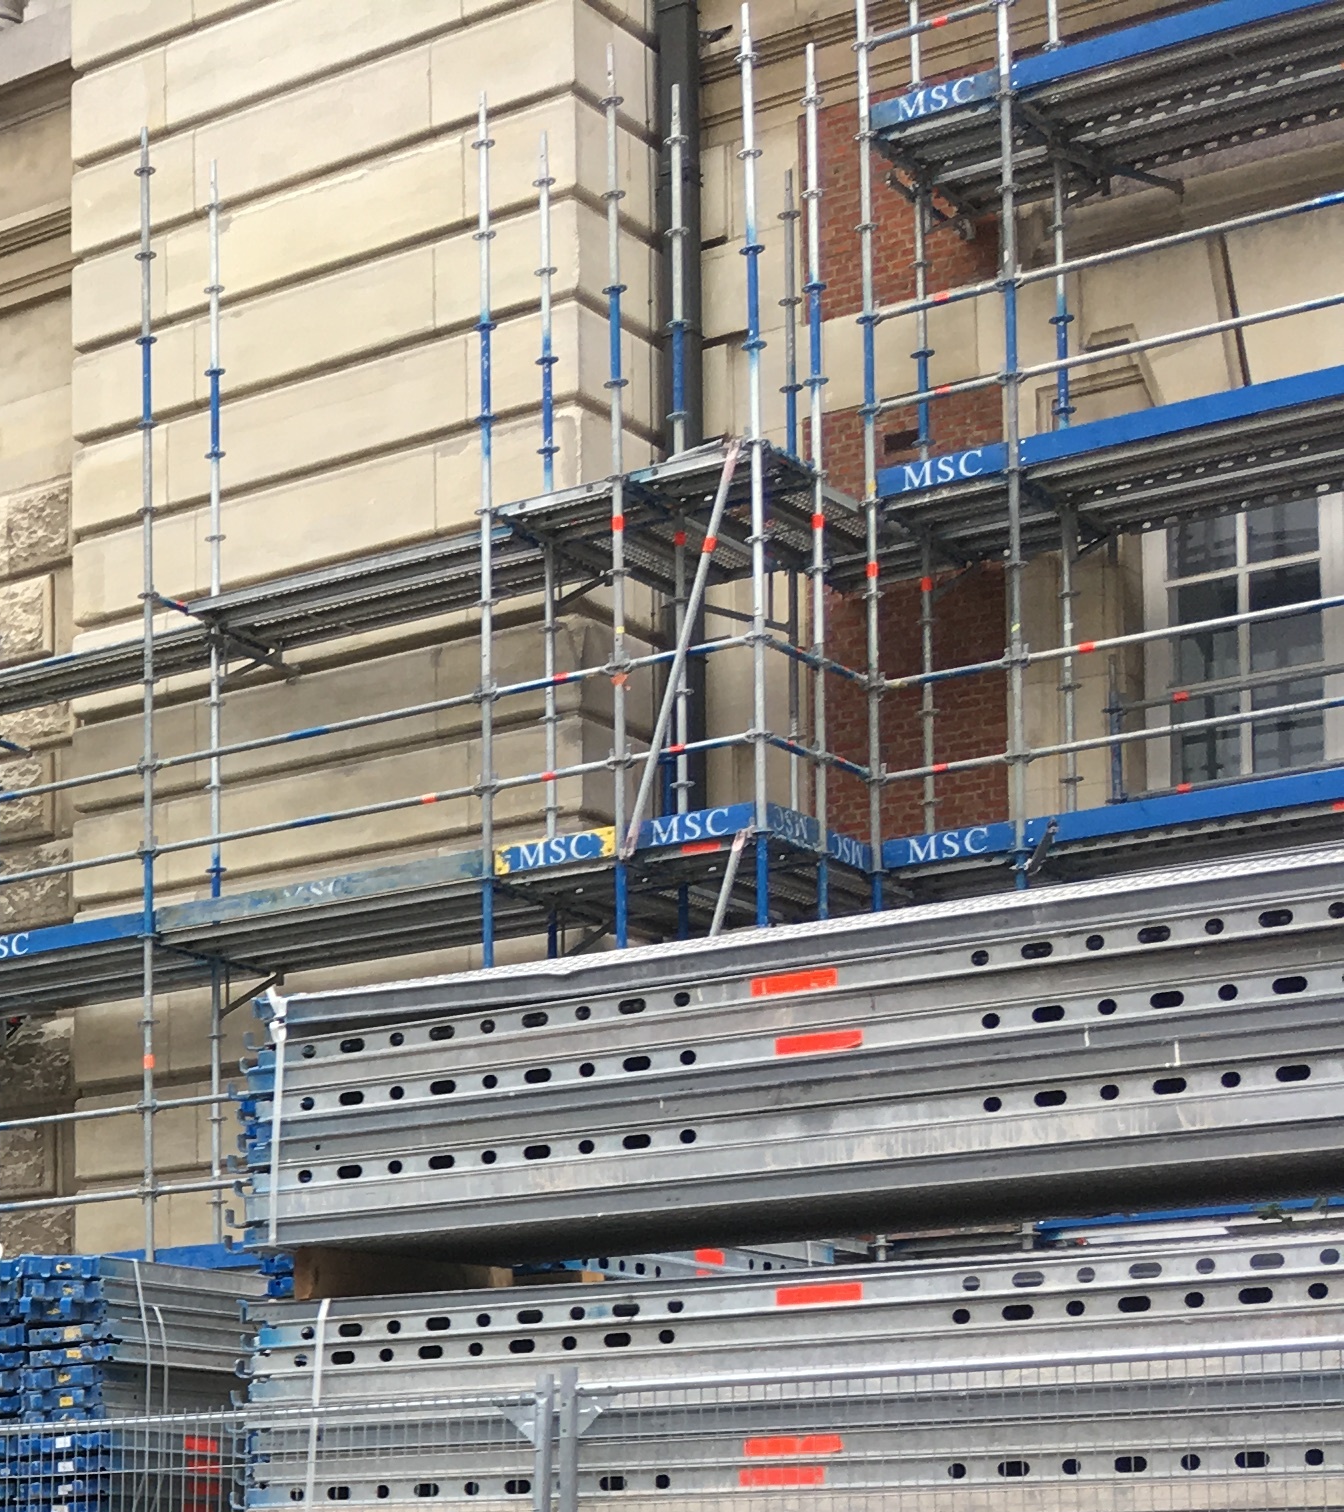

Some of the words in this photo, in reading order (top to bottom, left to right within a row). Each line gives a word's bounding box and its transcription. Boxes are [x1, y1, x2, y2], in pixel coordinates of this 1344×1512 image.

[898, 77, 975, 121] MSC
[902, 450, 983, 491] MSC
[650, 808, 730, 847] MSC
[907, 827, 988, 864] MSC
[518, 833, 593, 869] MSC
